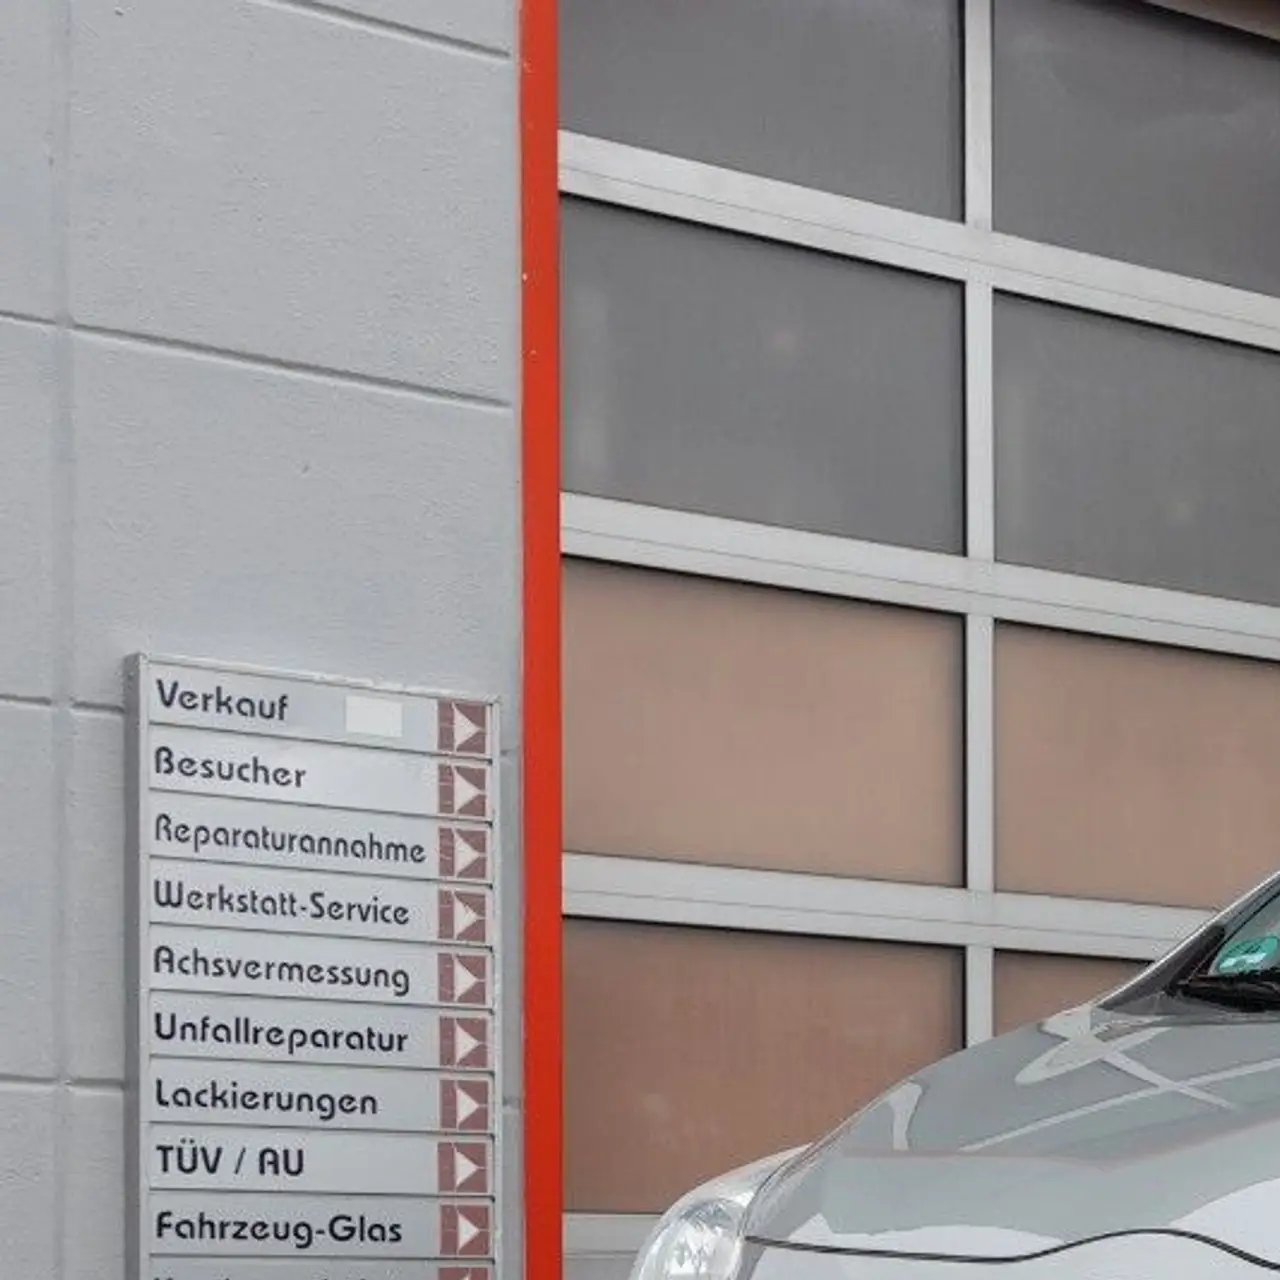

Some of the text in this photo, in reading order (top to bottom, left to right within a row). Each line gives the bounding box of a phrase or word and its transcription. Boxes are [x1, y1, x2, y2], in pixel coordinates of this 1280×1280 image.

[155, 678, 289, 721] Verkauf
[154, 746, 306, 788] Besucher
[154, 813, 427, 864] Reparaturannahme
[153, 879, 410, 926] Werkstatt-Service
[153, 945, 410, 997] Achsvermessung
[154, 1012, 410, 1055] Unfallreparatur
[155, 1079, 378, 1121] Lackierungen
[156, 1138, 305, 1177] TÜV / AU
[156, 1211, 403, 1249] Fahrzeug-Glas
